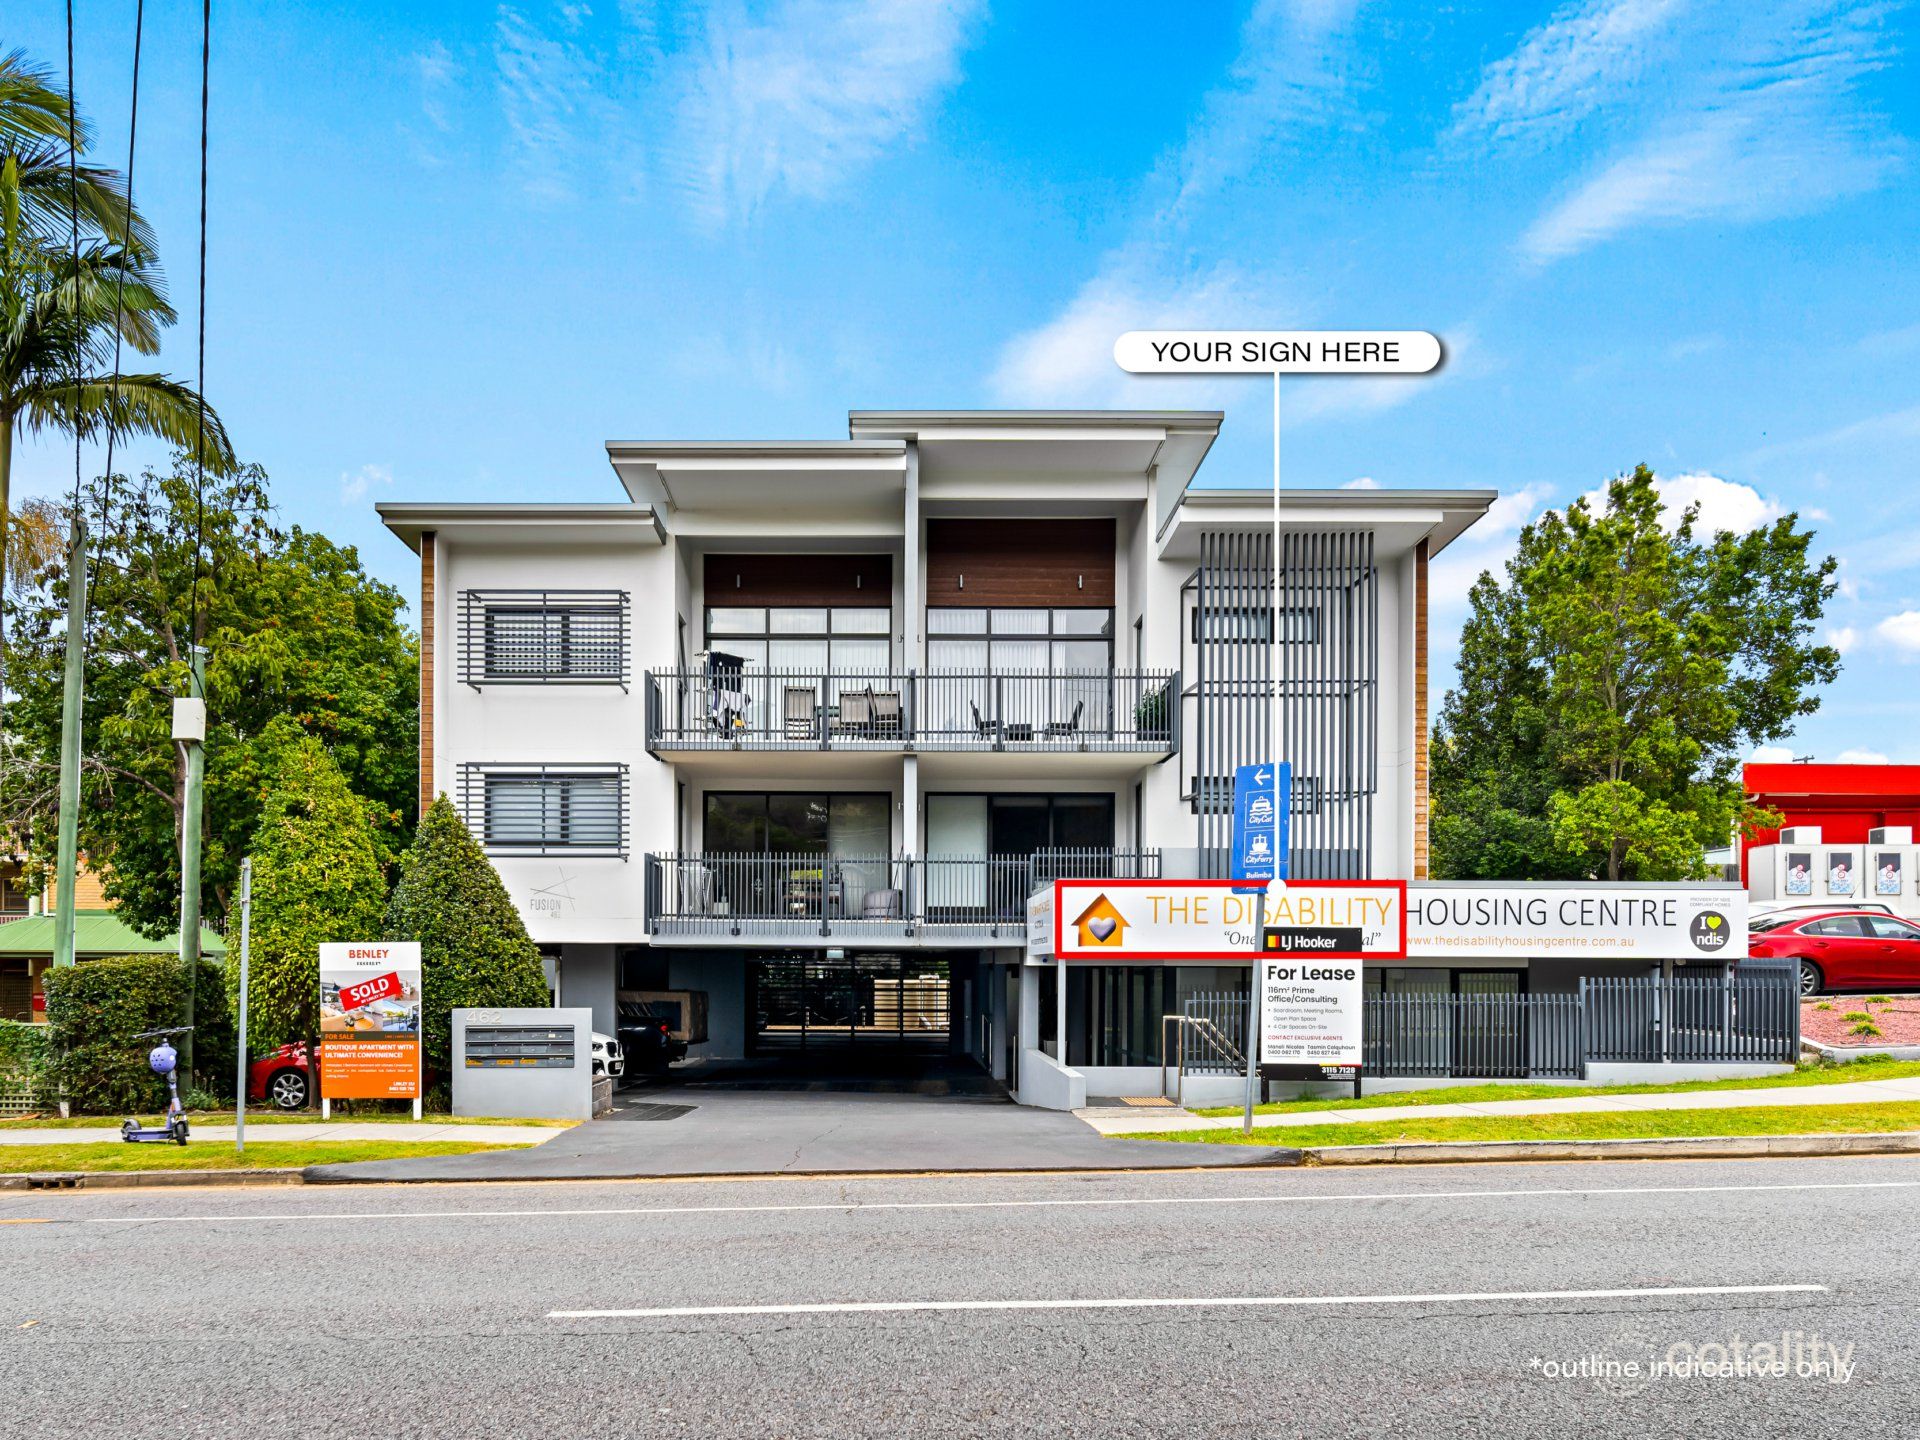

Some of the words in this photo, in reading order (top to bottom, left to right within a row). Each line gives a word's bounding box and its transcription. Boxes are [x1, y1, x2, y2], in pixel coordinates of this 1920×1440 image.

[1248, 815, 1272, 825] CityCat
[1245, 855, 1274, 865] CityFerry
[1245, 871, 1272, 879] Bulimba
[530, 898, 561, 911] FUSION
[1146, 896, 1209, 924] THE
[1223, 896, 1393, 925] DISABILITY
[1406, 898, 1547, 926] HOUSING
[1558, 899, 1677, 927] CENTRE
[1699, 916, 1707, 930] I
[1281, 935, 1292, 951] LJ
[1295, 935, 1337, 948] Hooker
[1406, 935, 1635, 949] www.thedisabilityhousingcentre.com.au
[1696, 932, 1724, 946] ndis
[348, 949, 389, 959] BENLEY
[1267, 966, 1297, 981] For
[1302, 966, 1356, 981] Lease
[350, 978, 389, 1001] SOLD
[1292, 986, 1315, 994] Prime
[1267, 995, 1338, 1005] Office/Consulting
[465, 1010, 502, 1024] 462
[1321, 1066, 1337, 1074] 3115
[1338, 1066, 1356, 1074] 7128
